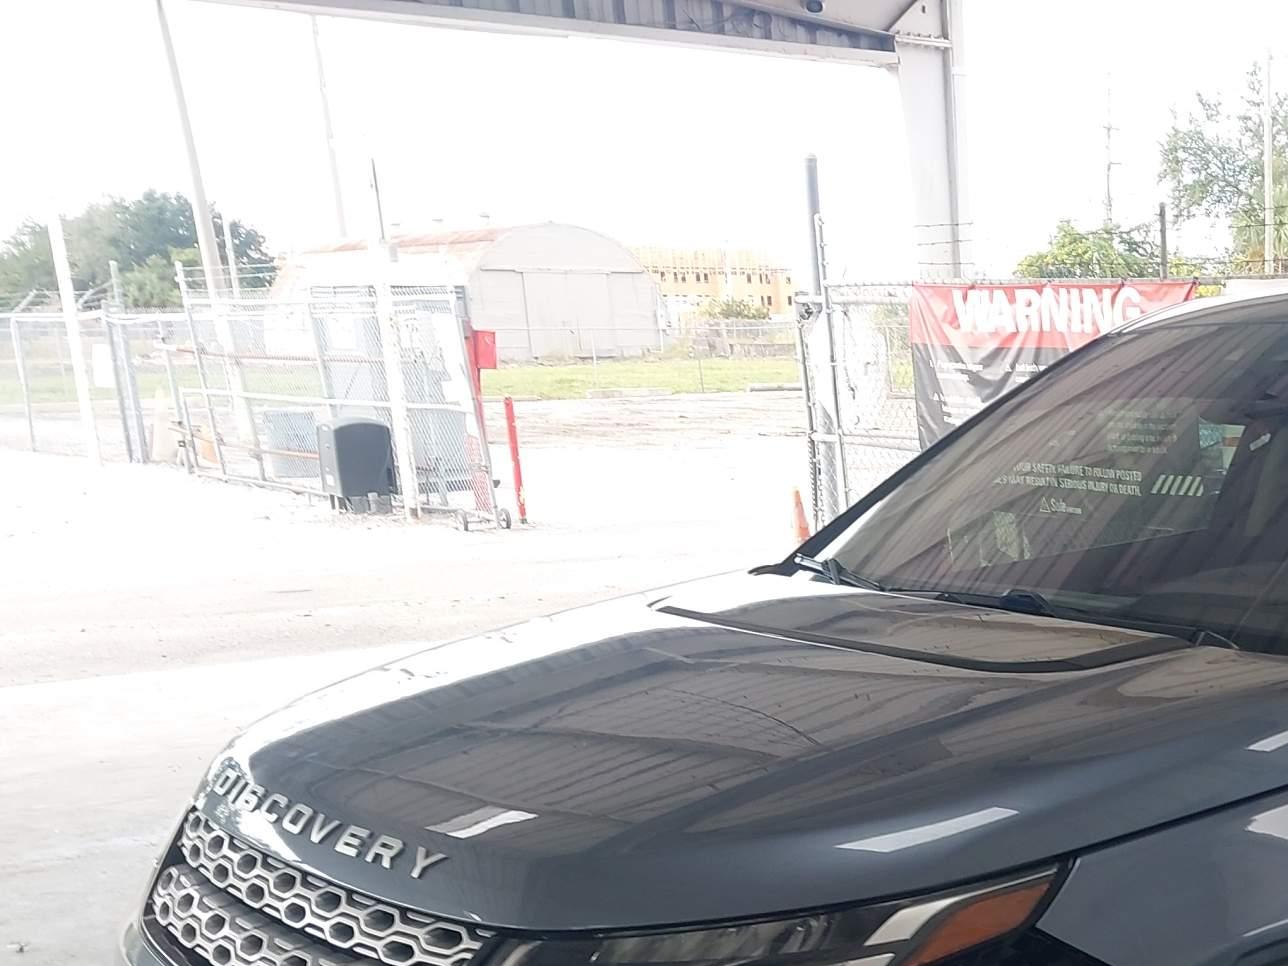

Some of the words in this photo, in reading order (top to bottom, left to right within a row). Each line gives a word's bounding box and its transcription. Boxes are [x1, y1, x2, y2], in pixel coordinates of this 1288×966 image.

[952, 286, 1142, 333] WARNING
[1059, 477, 1088, 491] SERIOUS
[1116, 468, 1143, 482] POSTED
[213, 767, 448, 880] DISCOVERY
